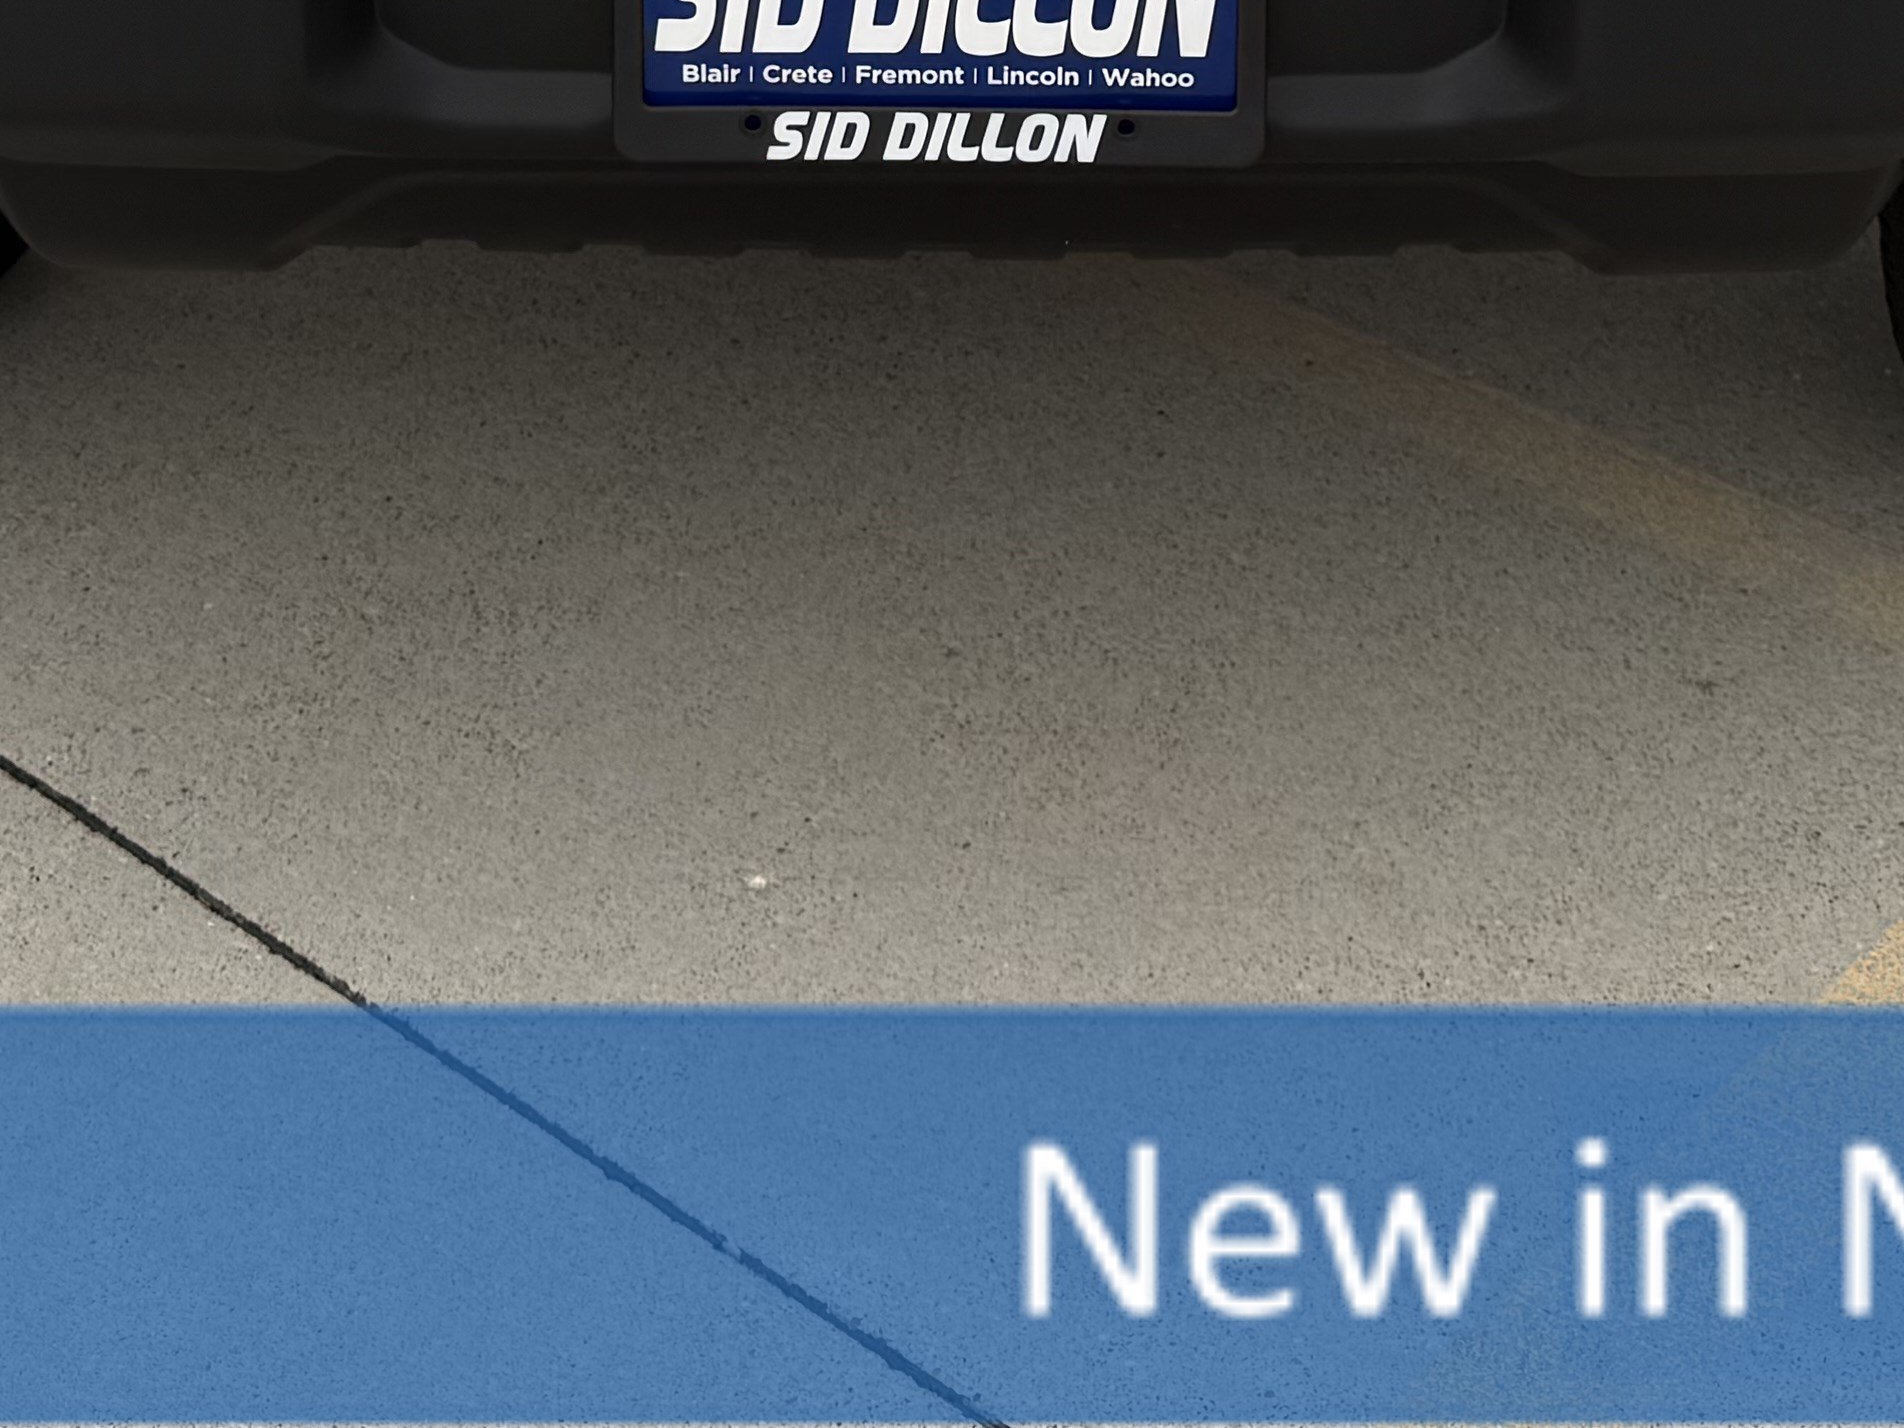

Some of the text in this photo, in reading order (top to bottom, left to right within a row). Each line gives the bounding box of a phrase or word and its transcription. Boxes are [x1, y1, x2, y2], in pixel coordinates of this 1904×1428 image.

[682, 63, 1195, 89] Blair Crete Fremont Lincoln Wahoo
[766, 110, 1108, 163] SID DILLON
